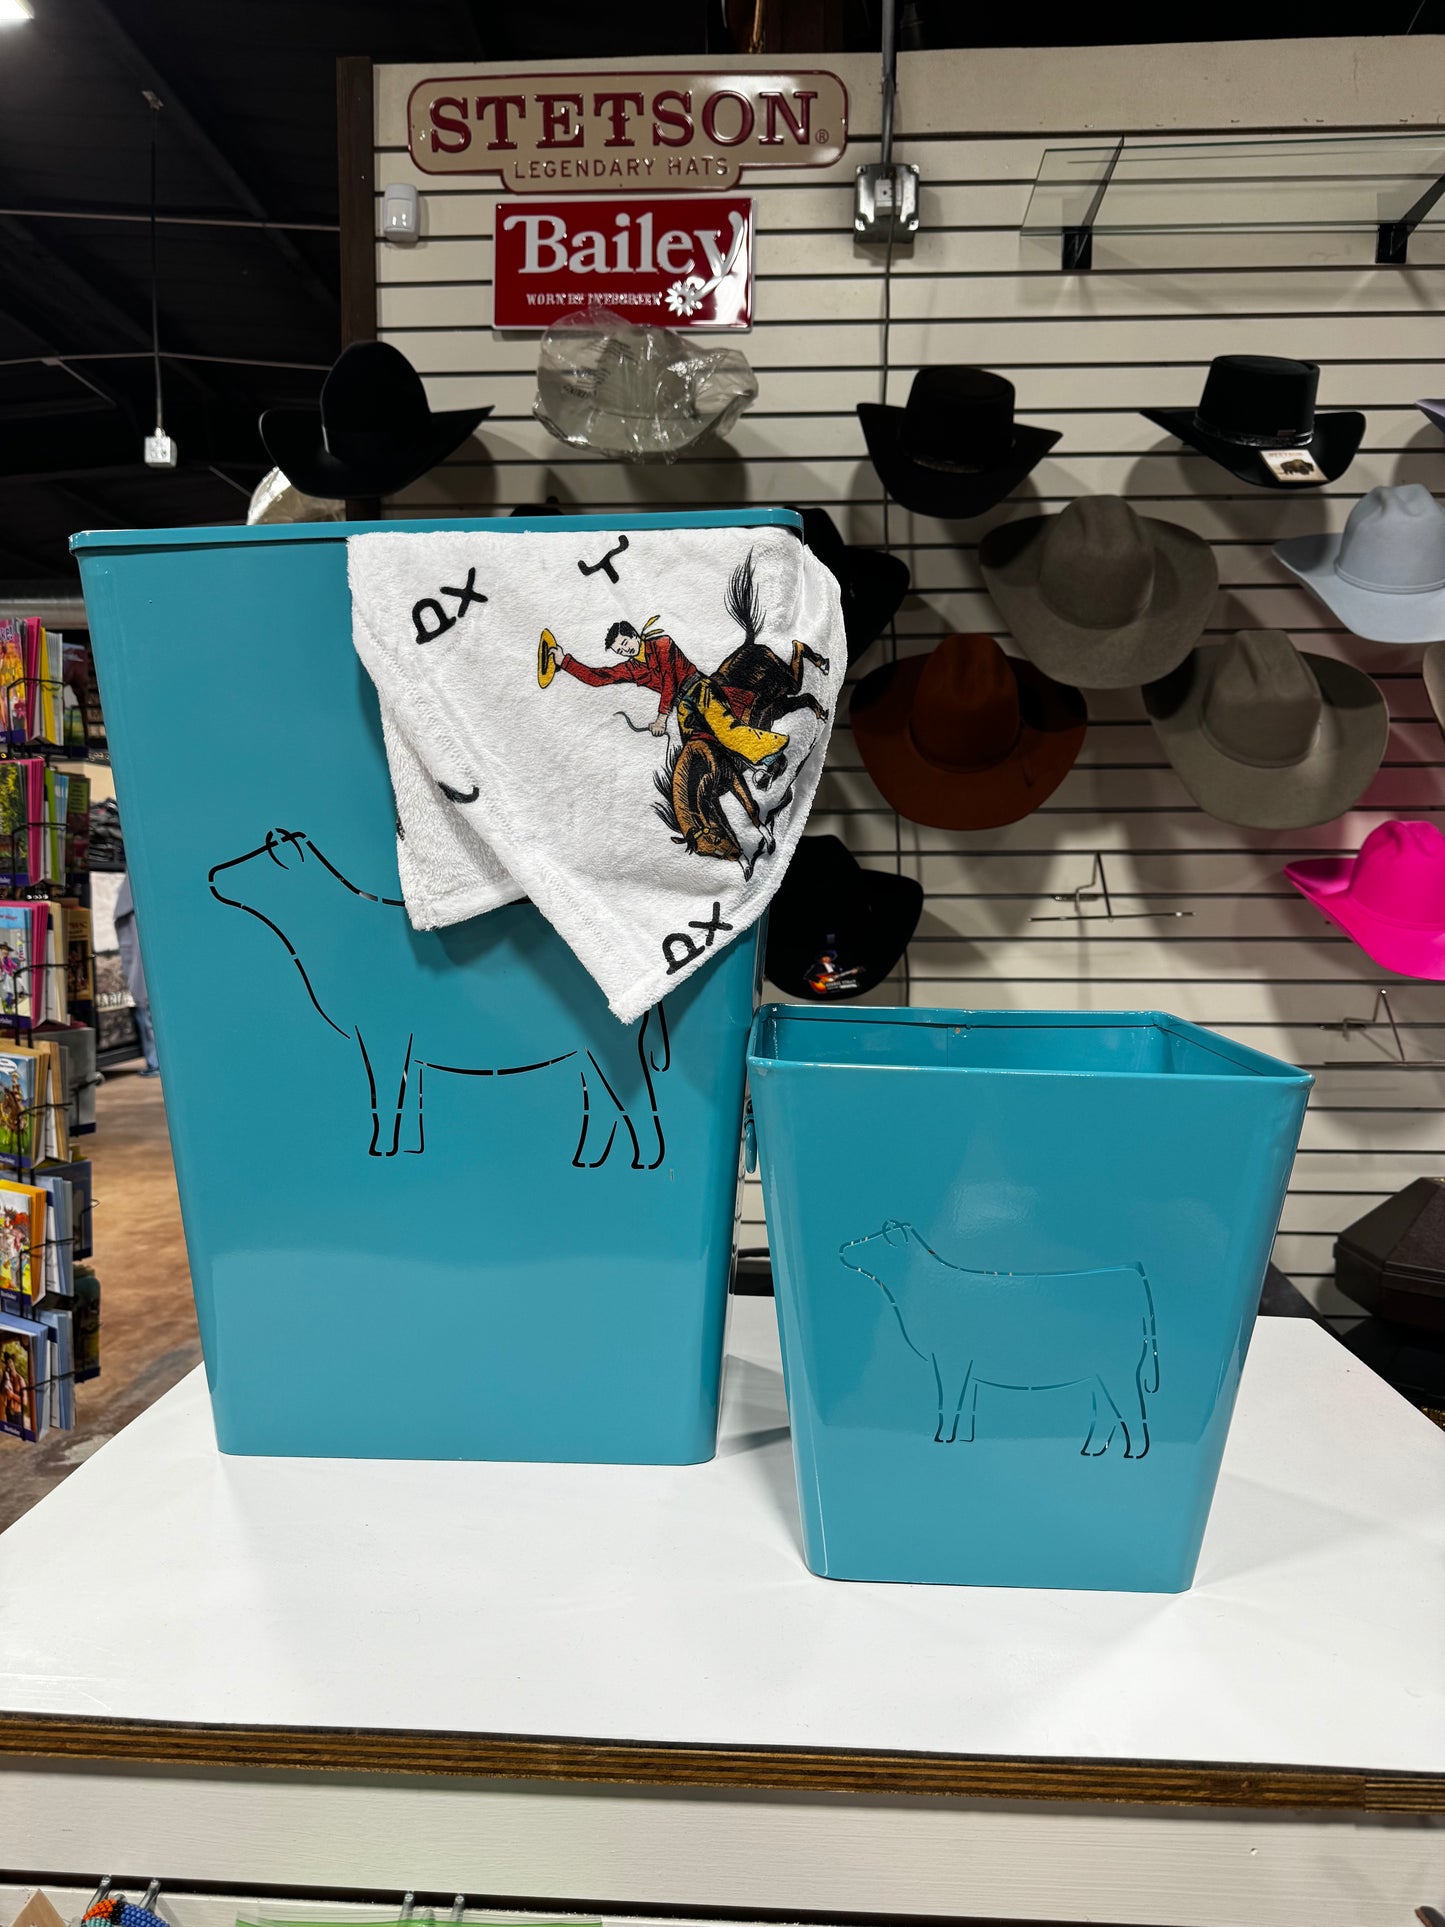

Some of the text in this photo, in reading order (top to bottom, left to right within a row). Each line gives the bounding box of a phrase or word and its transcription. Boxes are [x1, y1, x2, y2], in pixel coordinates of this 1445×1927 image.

[514, 157, 730, 179] LEGENDARY HATS
[503, 211, 744, 282] Bailey
[526, 293, 566, 306] WORN
